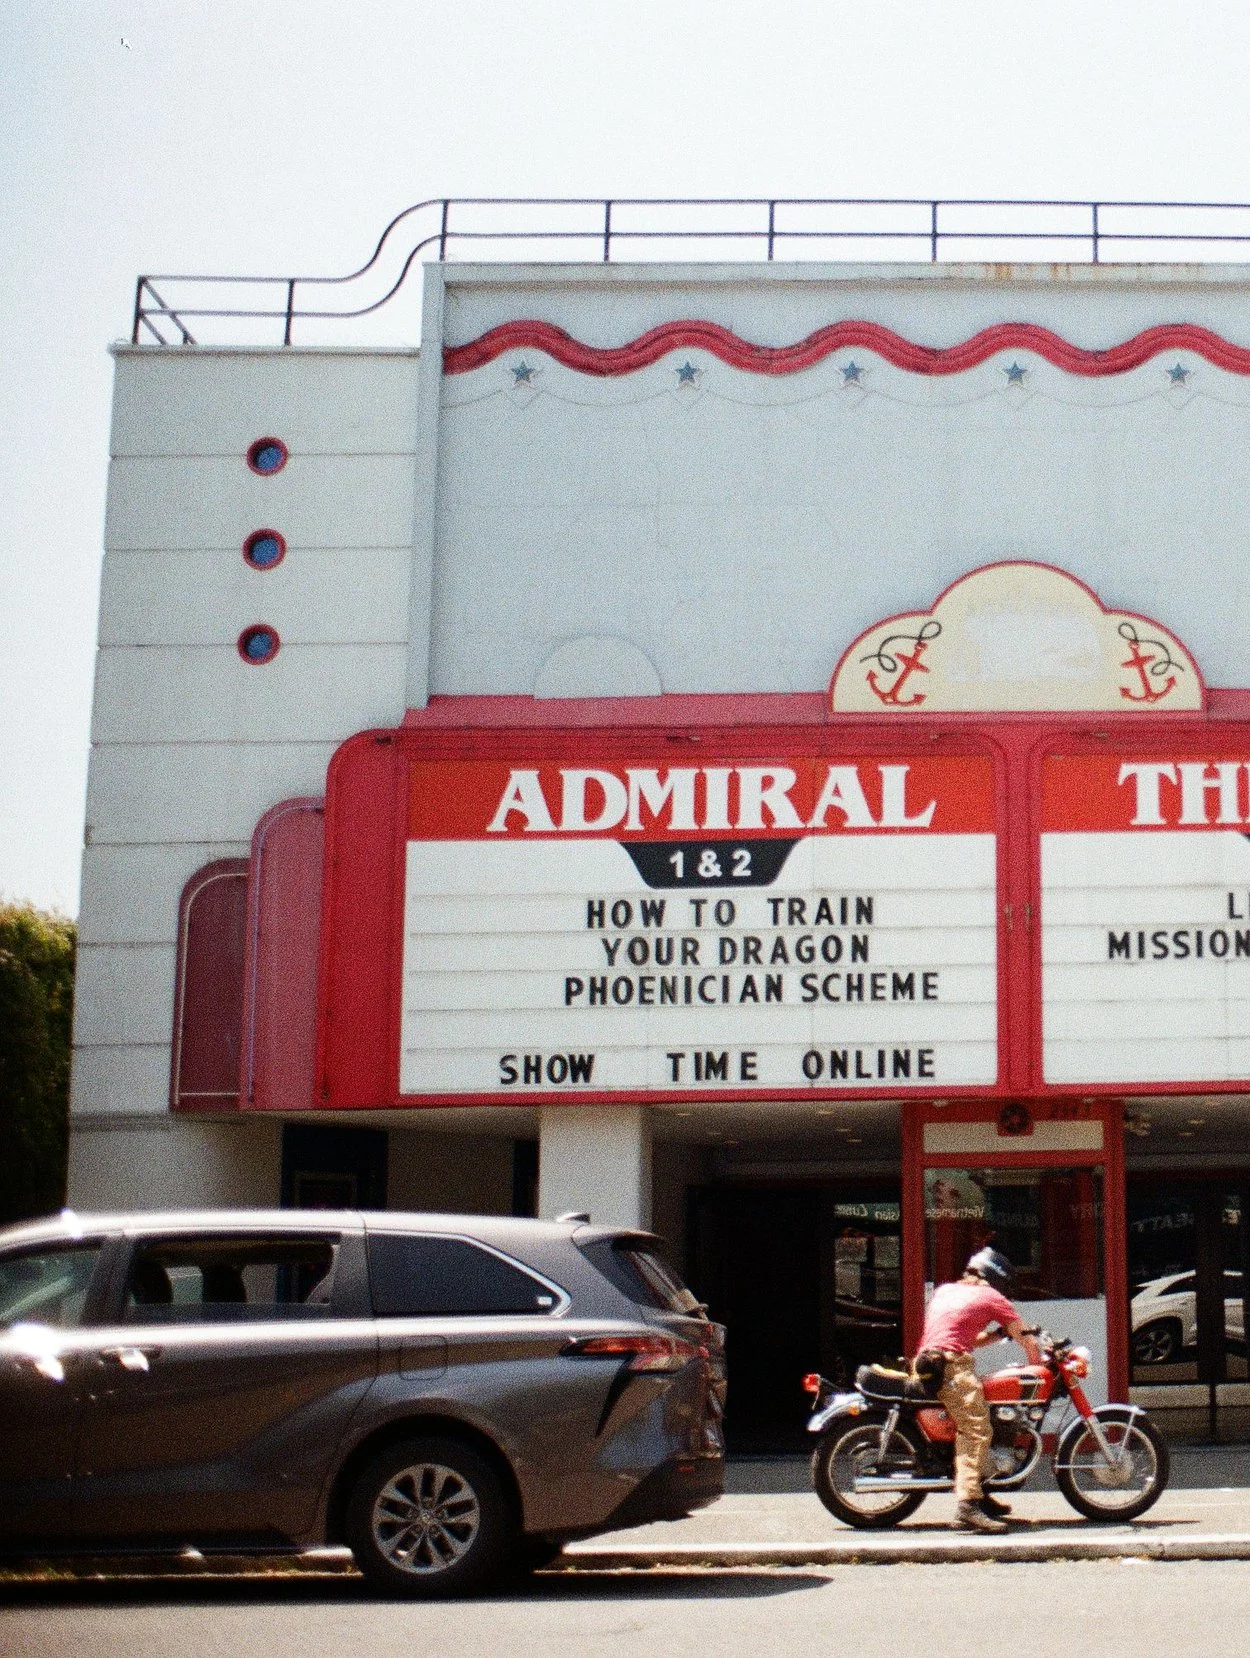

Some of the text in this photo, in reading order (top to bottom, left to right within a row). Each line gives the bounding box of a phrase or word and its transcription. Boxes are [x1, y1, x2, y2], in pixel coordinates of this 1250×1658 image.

[486, 764, 937, 832] ADMIRAL
[669, 852, 684, 878] 1
[732, 850, 752, 876] 2
[586, 896, 875, 928] HOW TO TRAIN
[600, 934, 870, 966] YOUR DRAGON
[564, 972, 939, 1006] PHOENICIAN SCHEME
[500, 1049, 936, 1084] SHOW TIME ONLINE
